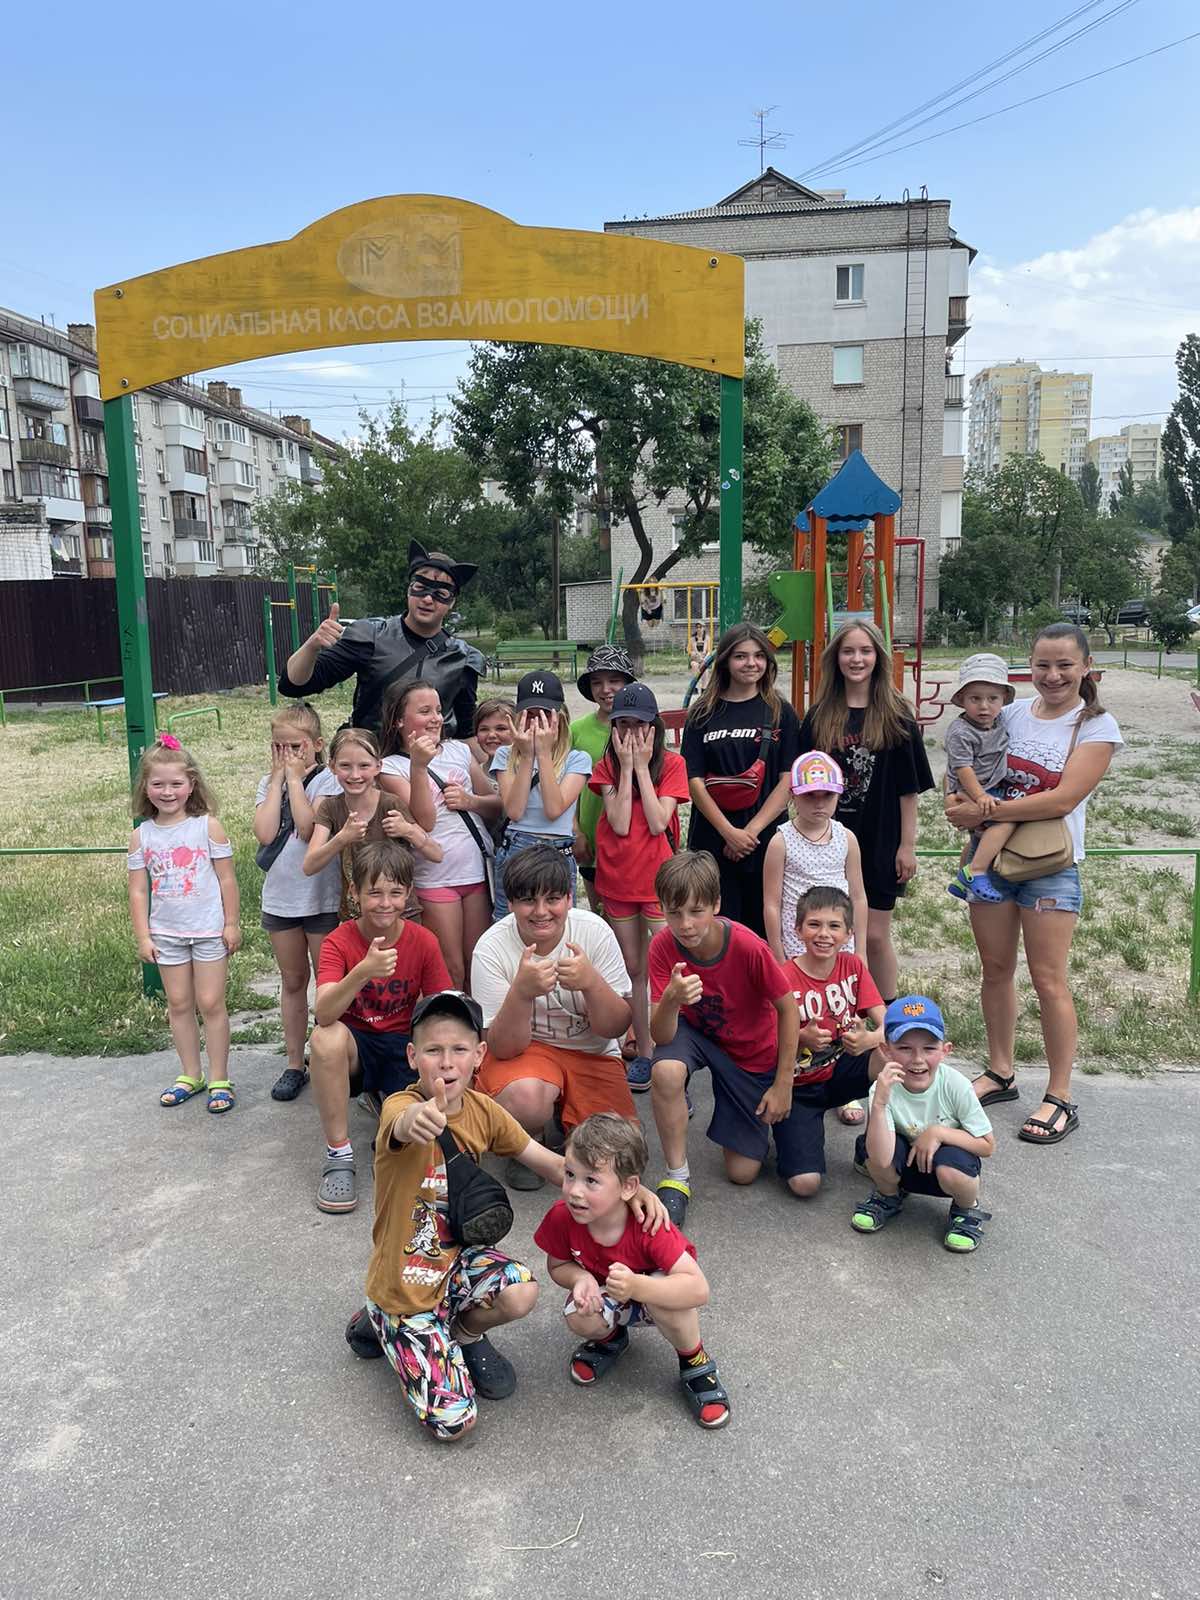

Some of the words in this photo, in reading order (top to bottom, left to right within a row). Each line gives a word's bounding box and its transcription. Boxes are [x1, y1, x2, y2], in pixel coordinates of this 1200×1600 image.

[151, 307, 321, 343] СОЦИАЛЬНАЯ
[328, 302, 412, 333] КАССА
[416, 293, 649, 328] ВЗАИМОПОМОЩИ
